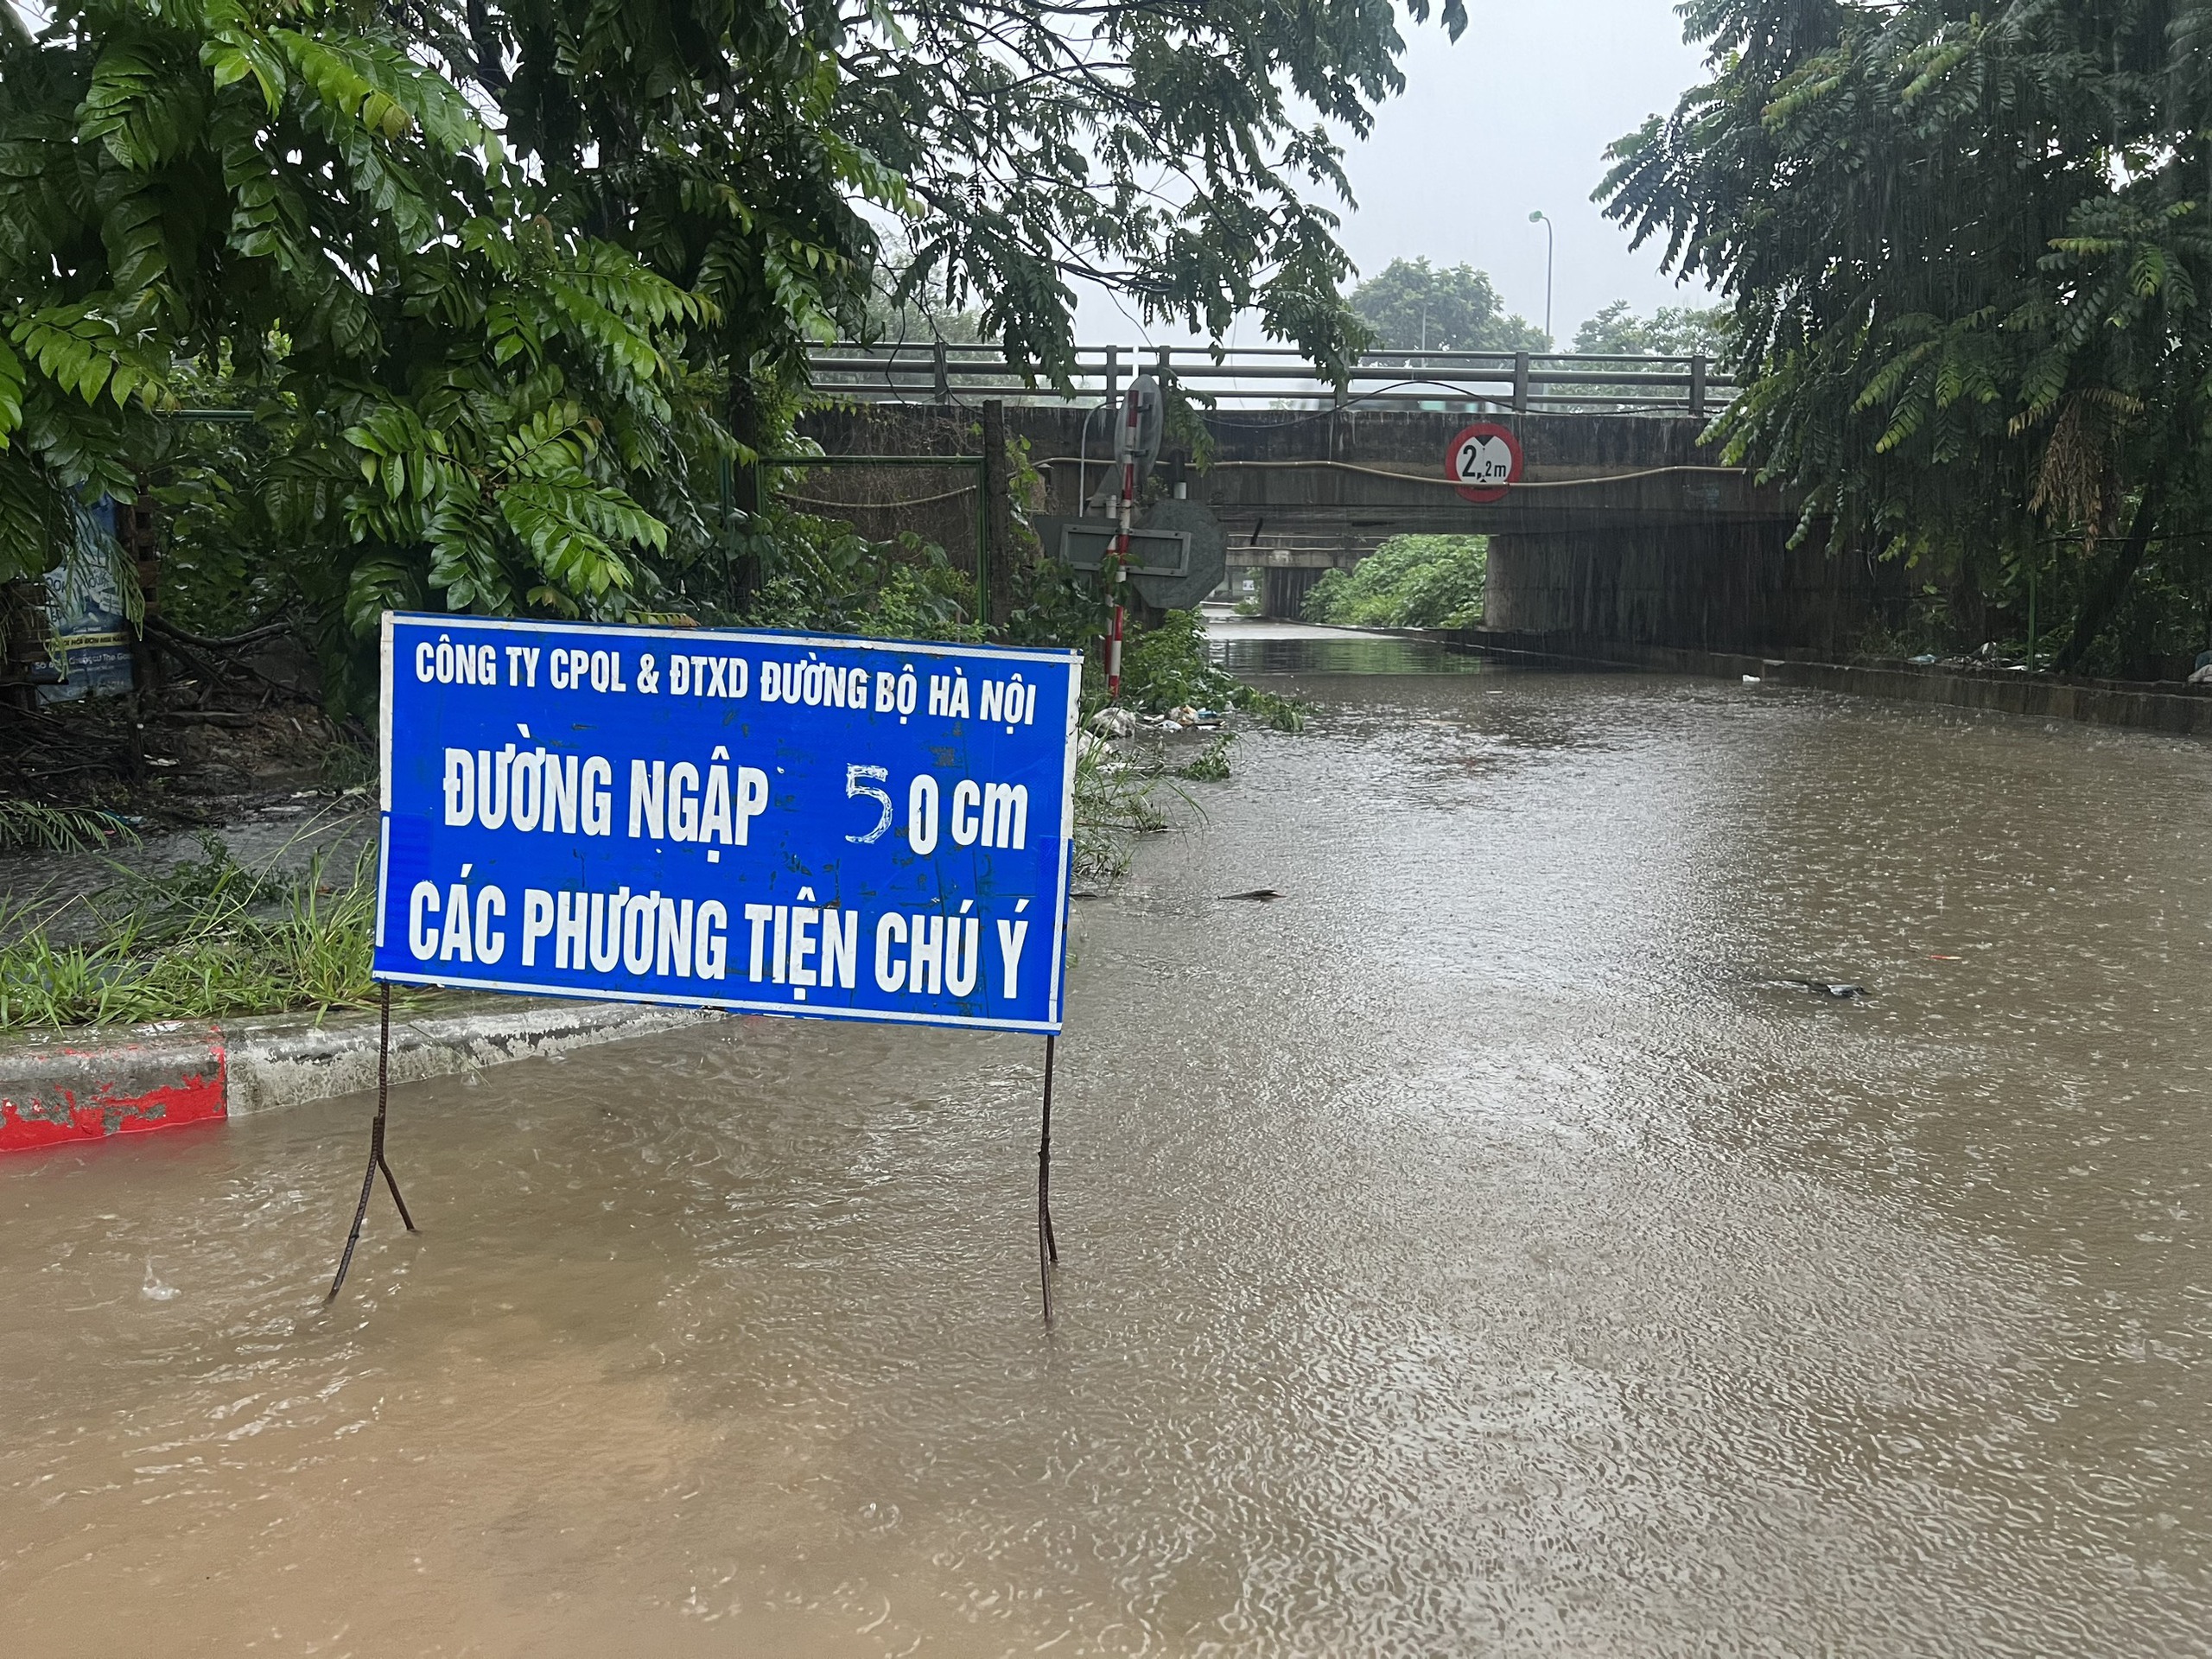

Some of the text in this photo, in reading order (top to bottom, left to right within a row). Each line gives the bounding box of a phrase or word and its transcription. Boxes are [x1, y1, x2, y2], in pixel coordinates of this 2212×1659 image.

[416, 633, 1037, 734] CÔNG TY CPQL & ĐTXD ĐƯỜNG BỘ HÀ NỘI
[442, 723, 611, 836] ĐƯỜNG
[628, 745, 769, 863] NGẬP
[409, 863, 1029, 1001] CÁC PHƯƠNG TIỆN CHÚ Ý
